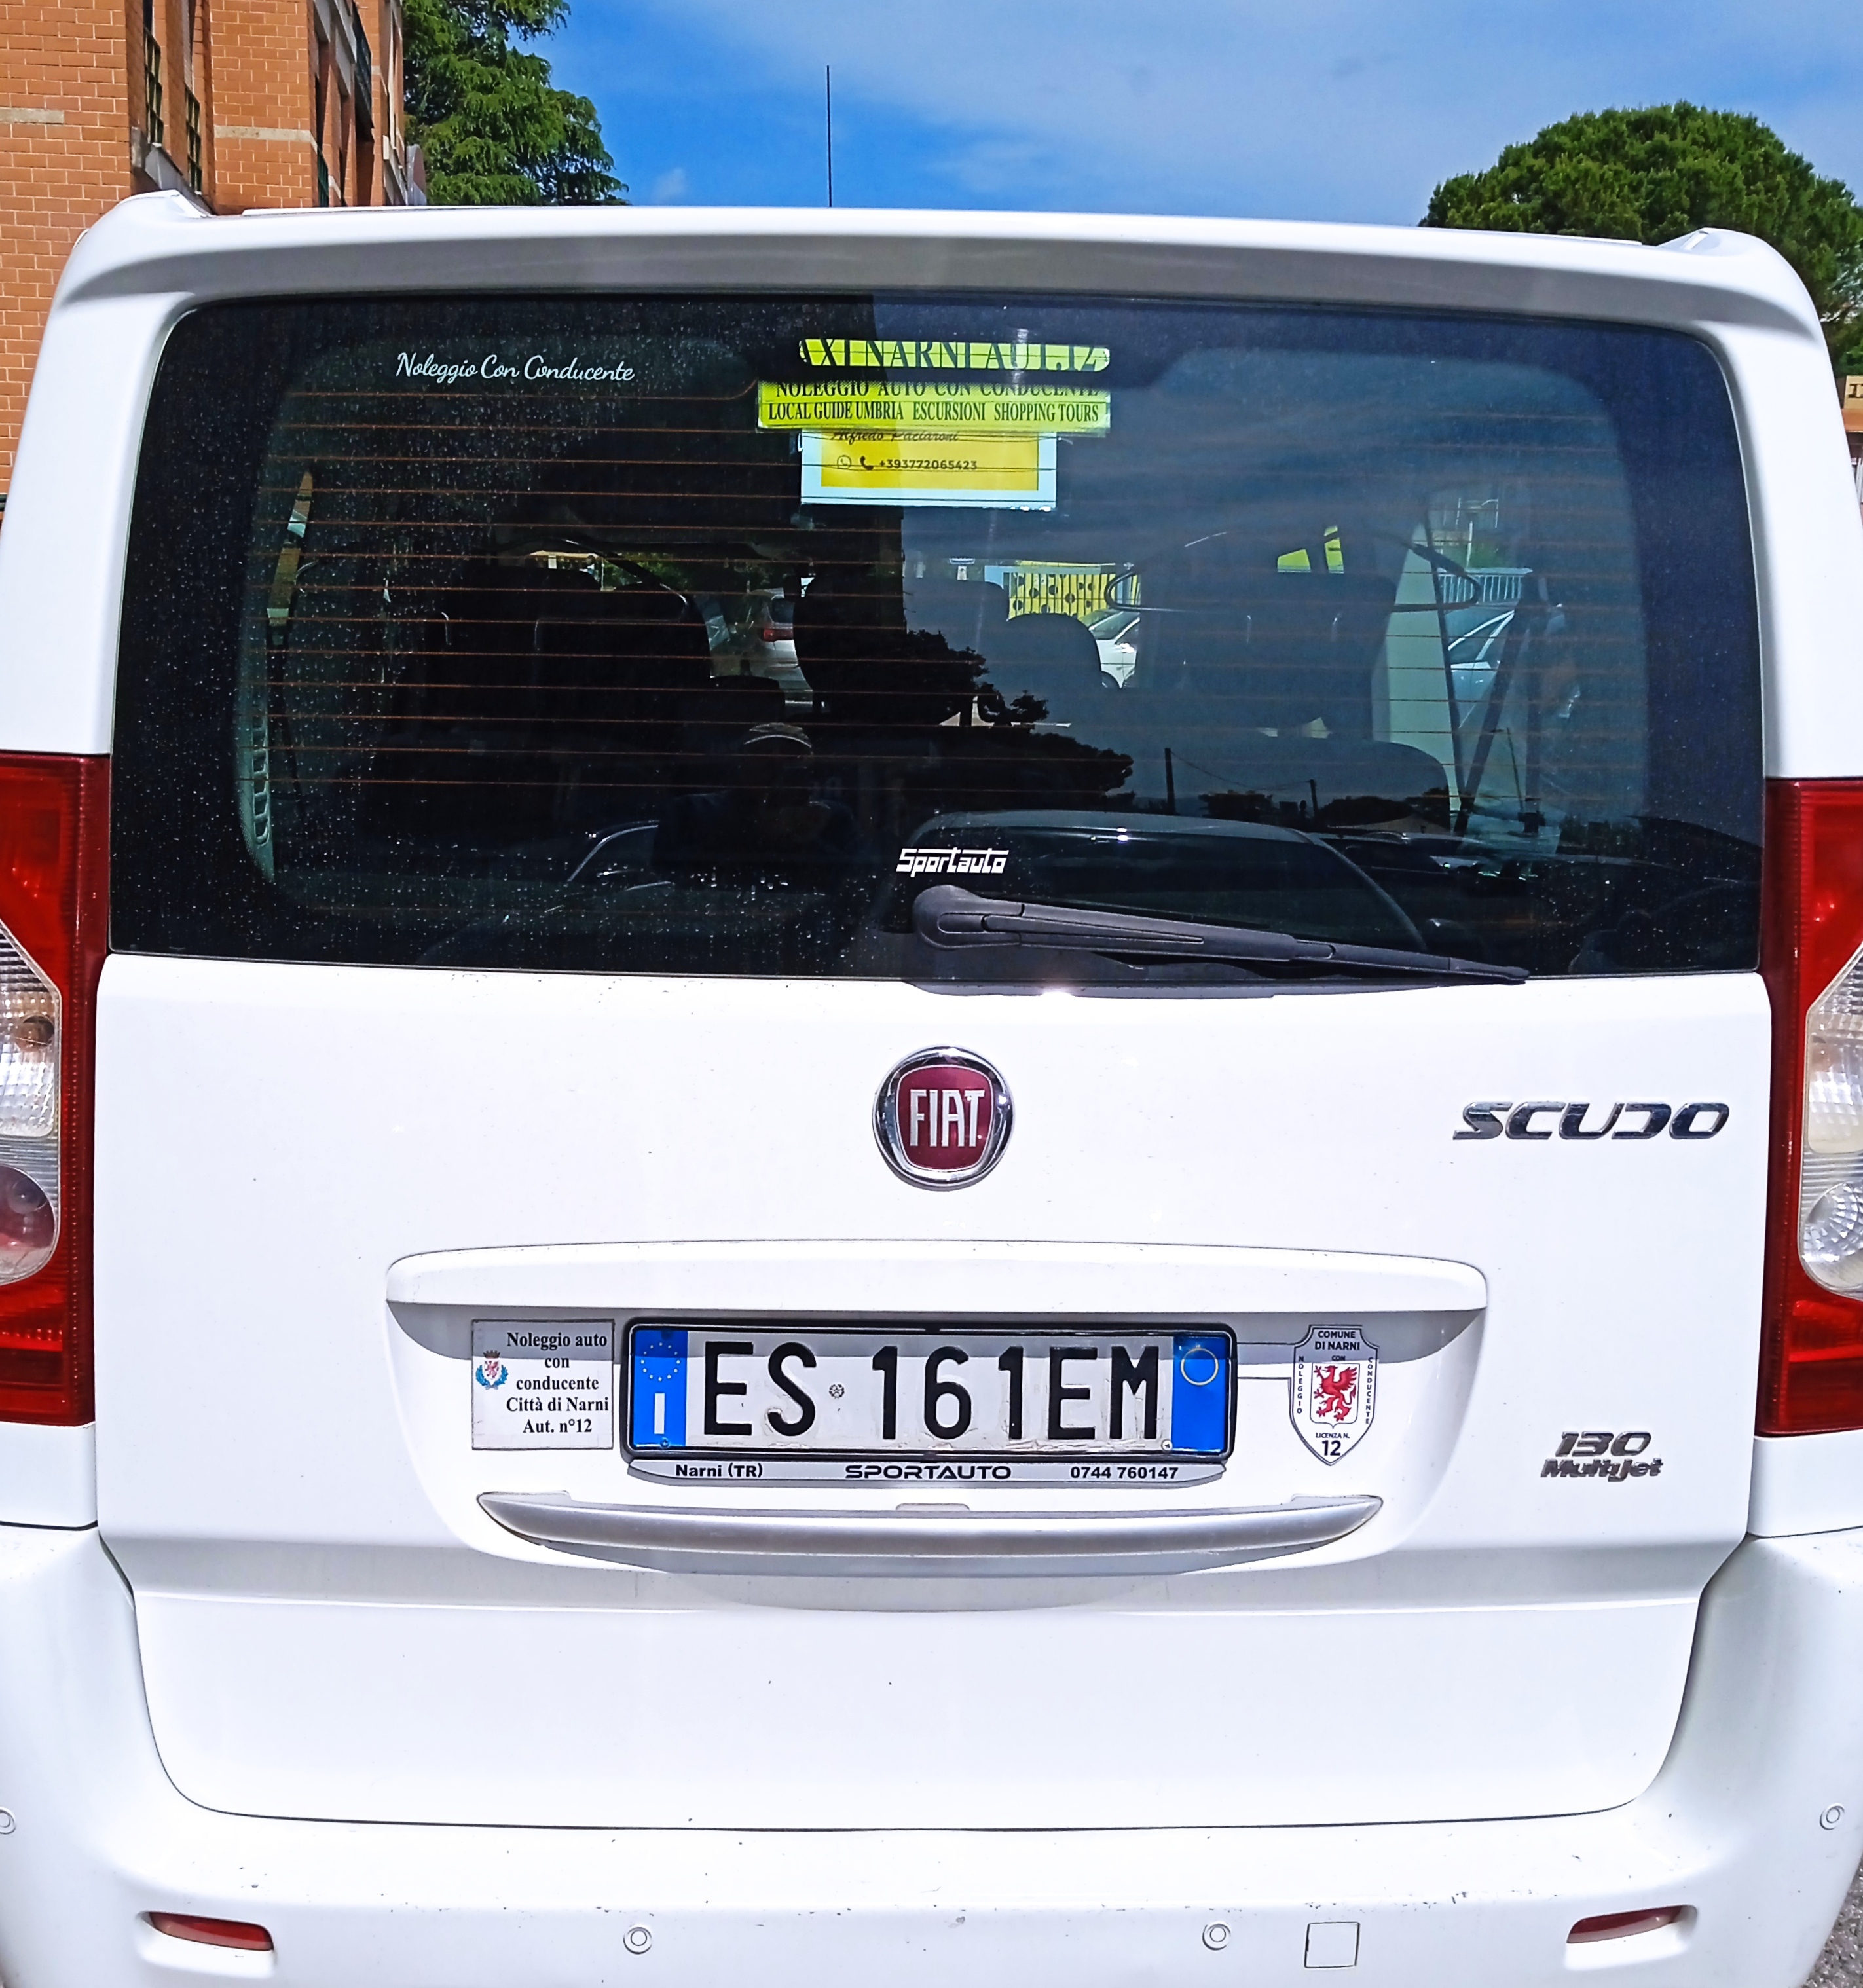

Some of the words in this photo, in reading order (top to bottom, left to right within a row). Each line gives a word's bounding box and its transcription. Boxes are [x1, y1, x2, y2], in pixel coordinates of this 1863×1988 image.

[866, 340, 971, 369] NARNI
[396, 352, 478, 384] Noleggio
[481, 354, 520, 379] Con
[524, 355, 635, 380] Conducente
[776, 381, 869, 397] NOLEGGIO
[877, 382, 925, 396] AUTO
[769, 401, 811, 420] LOCAL
[814, 401, 853, 419] GUIDE
[855, 401, 904, 420] UMBRIA
[913, 401, 986, 420] ESCURSIONI
[994, 403, 1055, 421] SHOPPING
[1058, 403, 1099, 422] TOURS
[879, 458, 978, 470] +393772065423
[896, 847, 1010, 878] Sportauto
[910, 1089, 985, 1147] FIAT
[1453, 1101, 1730, 1141] SCUDO
[507, 1332, 571, 1351] Noleggio
[575, 1333, 607, 1347] auto
[1318, 1330, 1356, 1338] COMUNE
[544, 1357, 570, 1369] con
[516, 1376, 599, 1390] conducente
[703, 1341, 817, 1437] ES
[872, 1346, 1159, 1441] 161EM
[1296, 1356, 1304, 1414] NOLEGGIO
[1365, 1357, 1374, 1424] CONDUCENTE
[506, 1397, 543, 1412] Città
[547, 1397, 562, 1411] di
[566, 1397, 609, 1412] Narni
[654, 1392, 665, 1435] I
[523, 1419, 555, 1433] Aut.
[559, 1418, 592, 1433] n°12
[1321, 1440, 1341, 1456] 12
[1555, 1431, 1651, 1457] 130
[675, 1464, 722, 1477] Narni
[728, 1463, 763, 1478] (TR)
[845, 1465, 1012, 1479] SPORTAUTO
[1070, 1467, 1112, 1479] 0744
[1117, 1467, 1179, 1479] 760147
